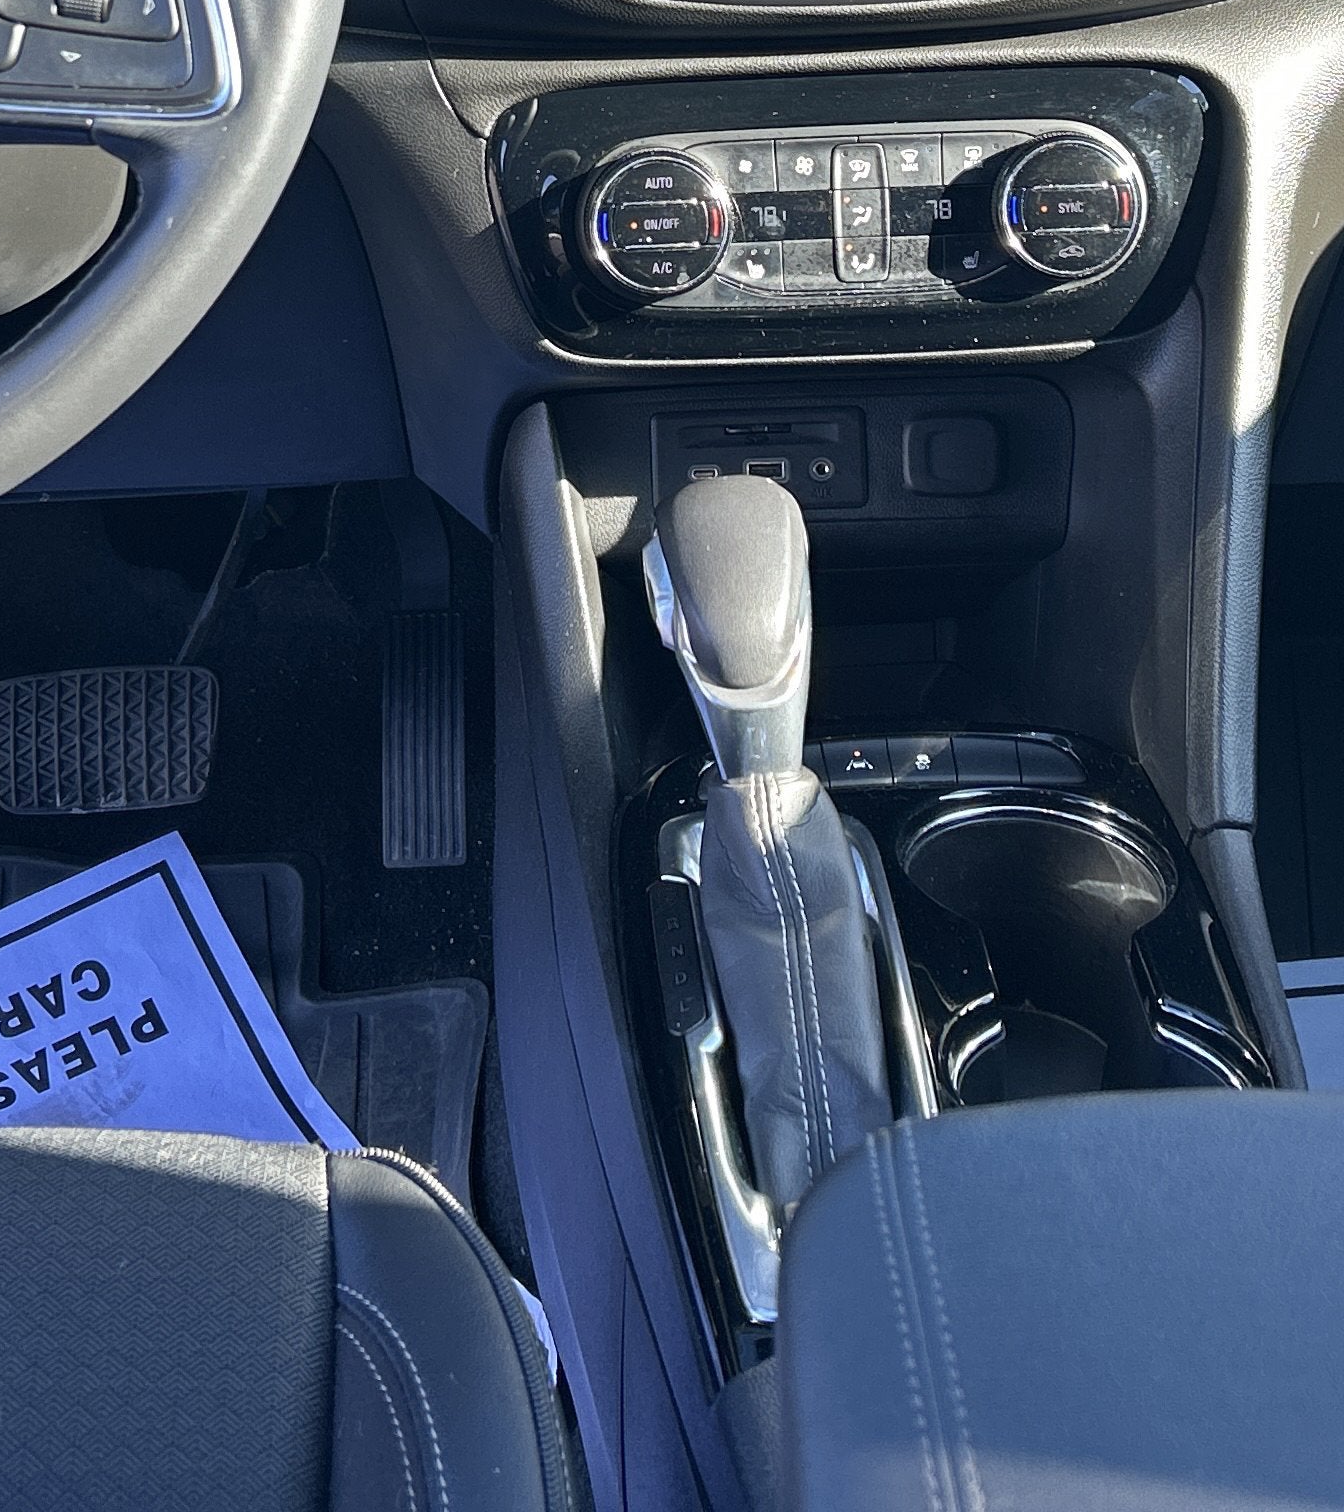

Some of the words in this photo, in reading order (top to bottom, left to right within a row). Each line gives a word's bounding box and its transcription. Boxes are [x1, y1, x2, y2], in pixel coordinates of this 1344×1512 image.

[645, 176, 673, 190] AUTO
[925, 199, 952, 220] 78
[1057, 200, 1085, 214] SYNC
[643, 218, 680, 231] ON/OFF
[652, 261, 673, 274] A/C
[671, 944, 685, 958] N
[674, 972, 687, 986] D
